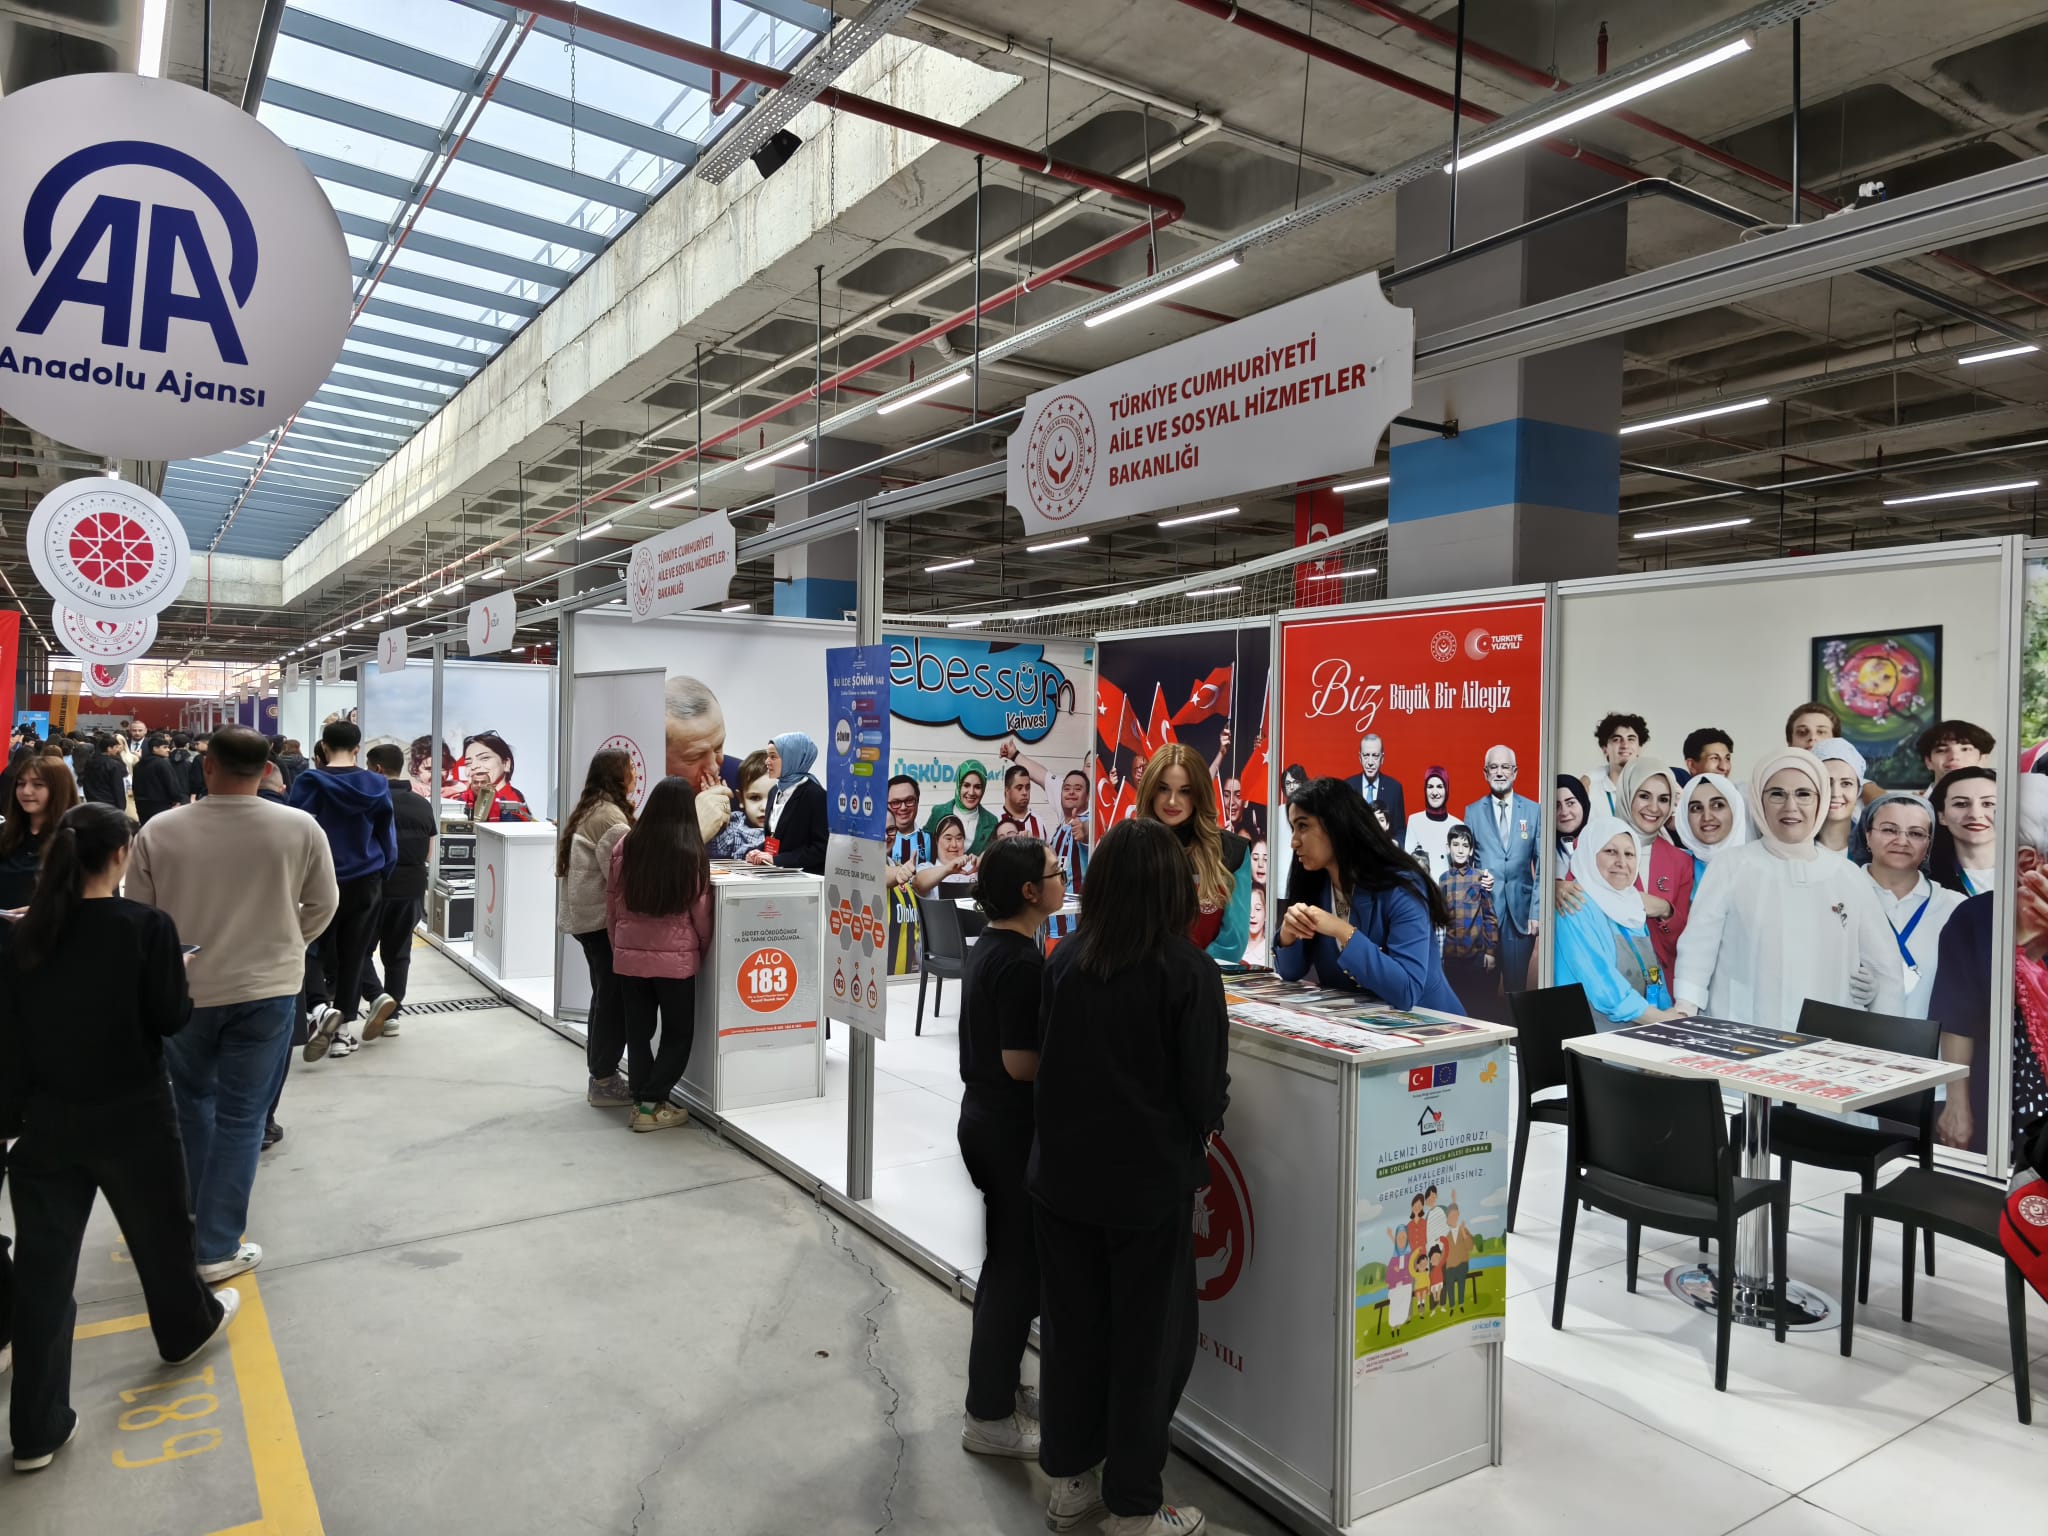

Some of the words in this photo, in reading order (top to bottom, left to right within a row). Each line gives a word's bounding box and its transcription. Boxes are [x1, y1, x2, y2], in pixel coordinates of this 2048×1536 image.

[0, 345, 146, 391] Anadolu
[155, 369, 266, 408] Ajansı
[1109, 381, 1177, 421] TÜRKİYE
[1180, 332, 1317, 399] CUMHURİYETİ
[1108, 422, 1144, 454] AİLE
[1146, 420, 1168, 444] VE
[1171, 399, 1241, 439] SOSYAL
[1244, 363, 1367, 418] HİZMETLER
[1108, 444, 1200, 487] BAKANLIĞI
[55, 548, 101, 598] İLETİŞİM
[110, 553, 168, 601] BAŞKANLIĞI
[675, 561, 695, 576] SOSYAL
[890, 636, 1076, 715] ebessüm
[1305, 658, 1383, 733] Biz
[1389, 682, 1431, 715] Büyük
[1434, 681, 1457, 710] Bir
[1461, 680, 1511, 714] Aileyiz
[1005, 711, 1048, 731] Kahvesi
[894, 758, 957, 783] ÜSKÜD
[754, 952, 783, 966] ALO
[747, 966, 788, 994] 183
[1378, 1143, 1419, 1165] AİLEMİZİ
[1422, 1130, 1489, 1154] BÜYÜTÜYORUZ!
[1408, 1163, 1457, 1184] HAYALLERİNİ
[1212, 1339, 1244, 1373] YILI
